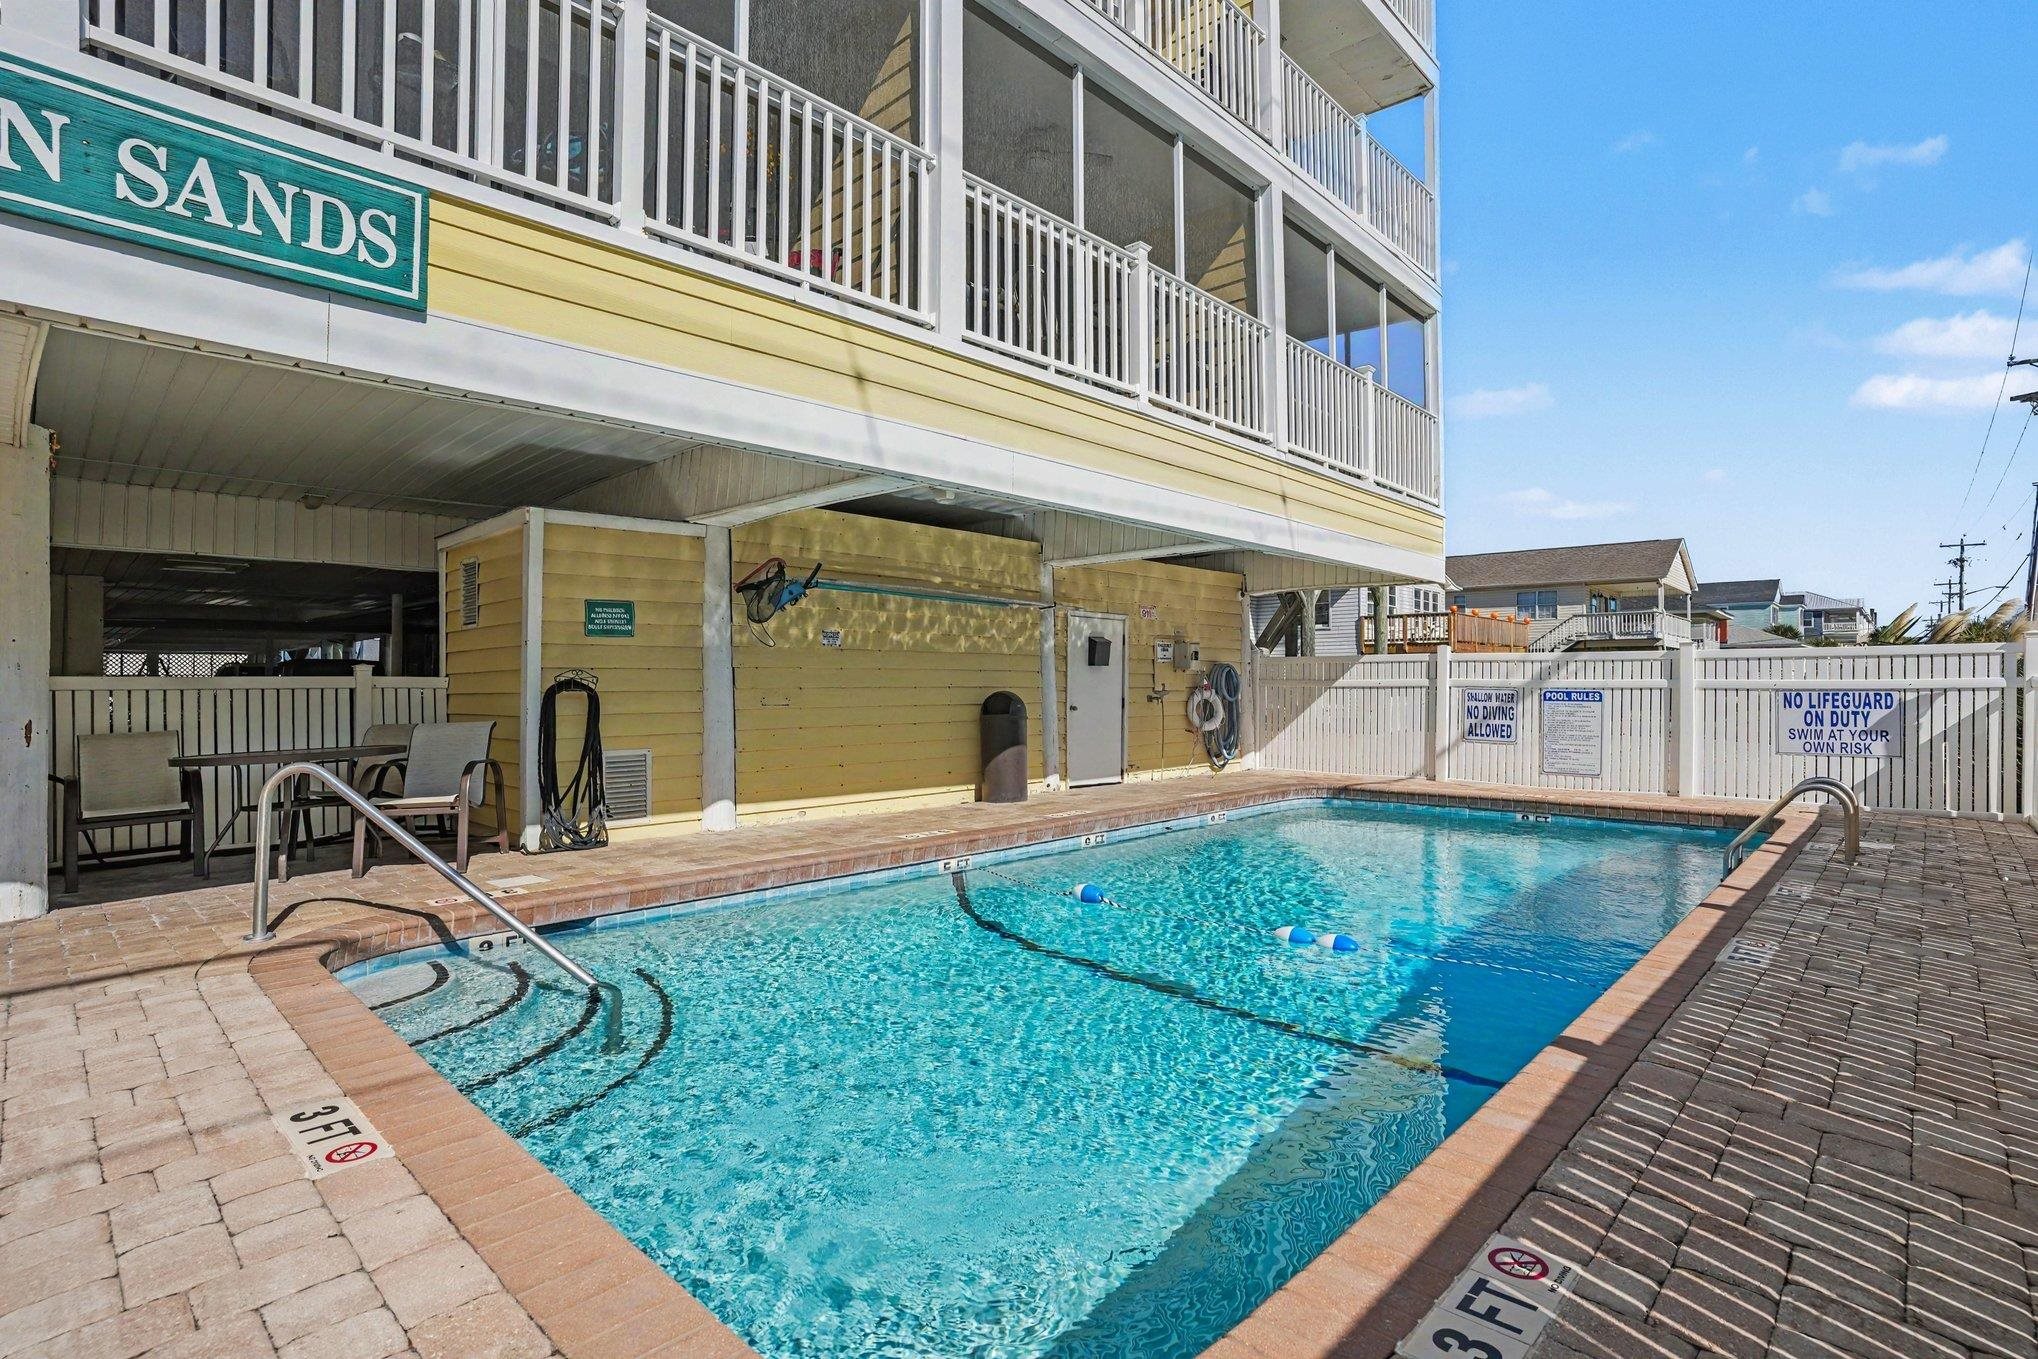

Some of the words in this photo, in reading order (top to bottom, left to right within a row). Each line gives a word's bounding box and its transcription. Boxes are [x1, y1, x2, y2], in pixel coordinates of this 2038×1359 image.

[116, 138, 397, 268] SANDS
[1467, 692, 1493, 703] SHALLOW
[1495, 692, 1515, 704] WATER
[1545, 692, 1569, 701] POOL
[1571, 692, 1600, 701] RULES
[1783, 692, 1803, 709] NO
[1808, 692, 1894, 710] LIFEGUARD
[1467, 705, 1480, 720] NO
[1482, 705, 1515, 721] DIVING
[1804, 710, 1824, 727] ON
[1830, 710, 1871, 728] DUTY
[1467, 722, 1513, 739] ALLOWED
[1788, 728, 1824, 741] SWIM
[1828, 729, 1844, 741] AT
[1849, 729, 1890, 742] YOUR
[1803, 741, 1835, 754] OWN
[1840, 742, 1873, 755] RISK
[290, 1105, 340, 1122] 3
[298, 1118, 362, 1145] FT
[1456, 1276, 1539, 1335] FT
[1432, 1327, 1503, 1359] 3
